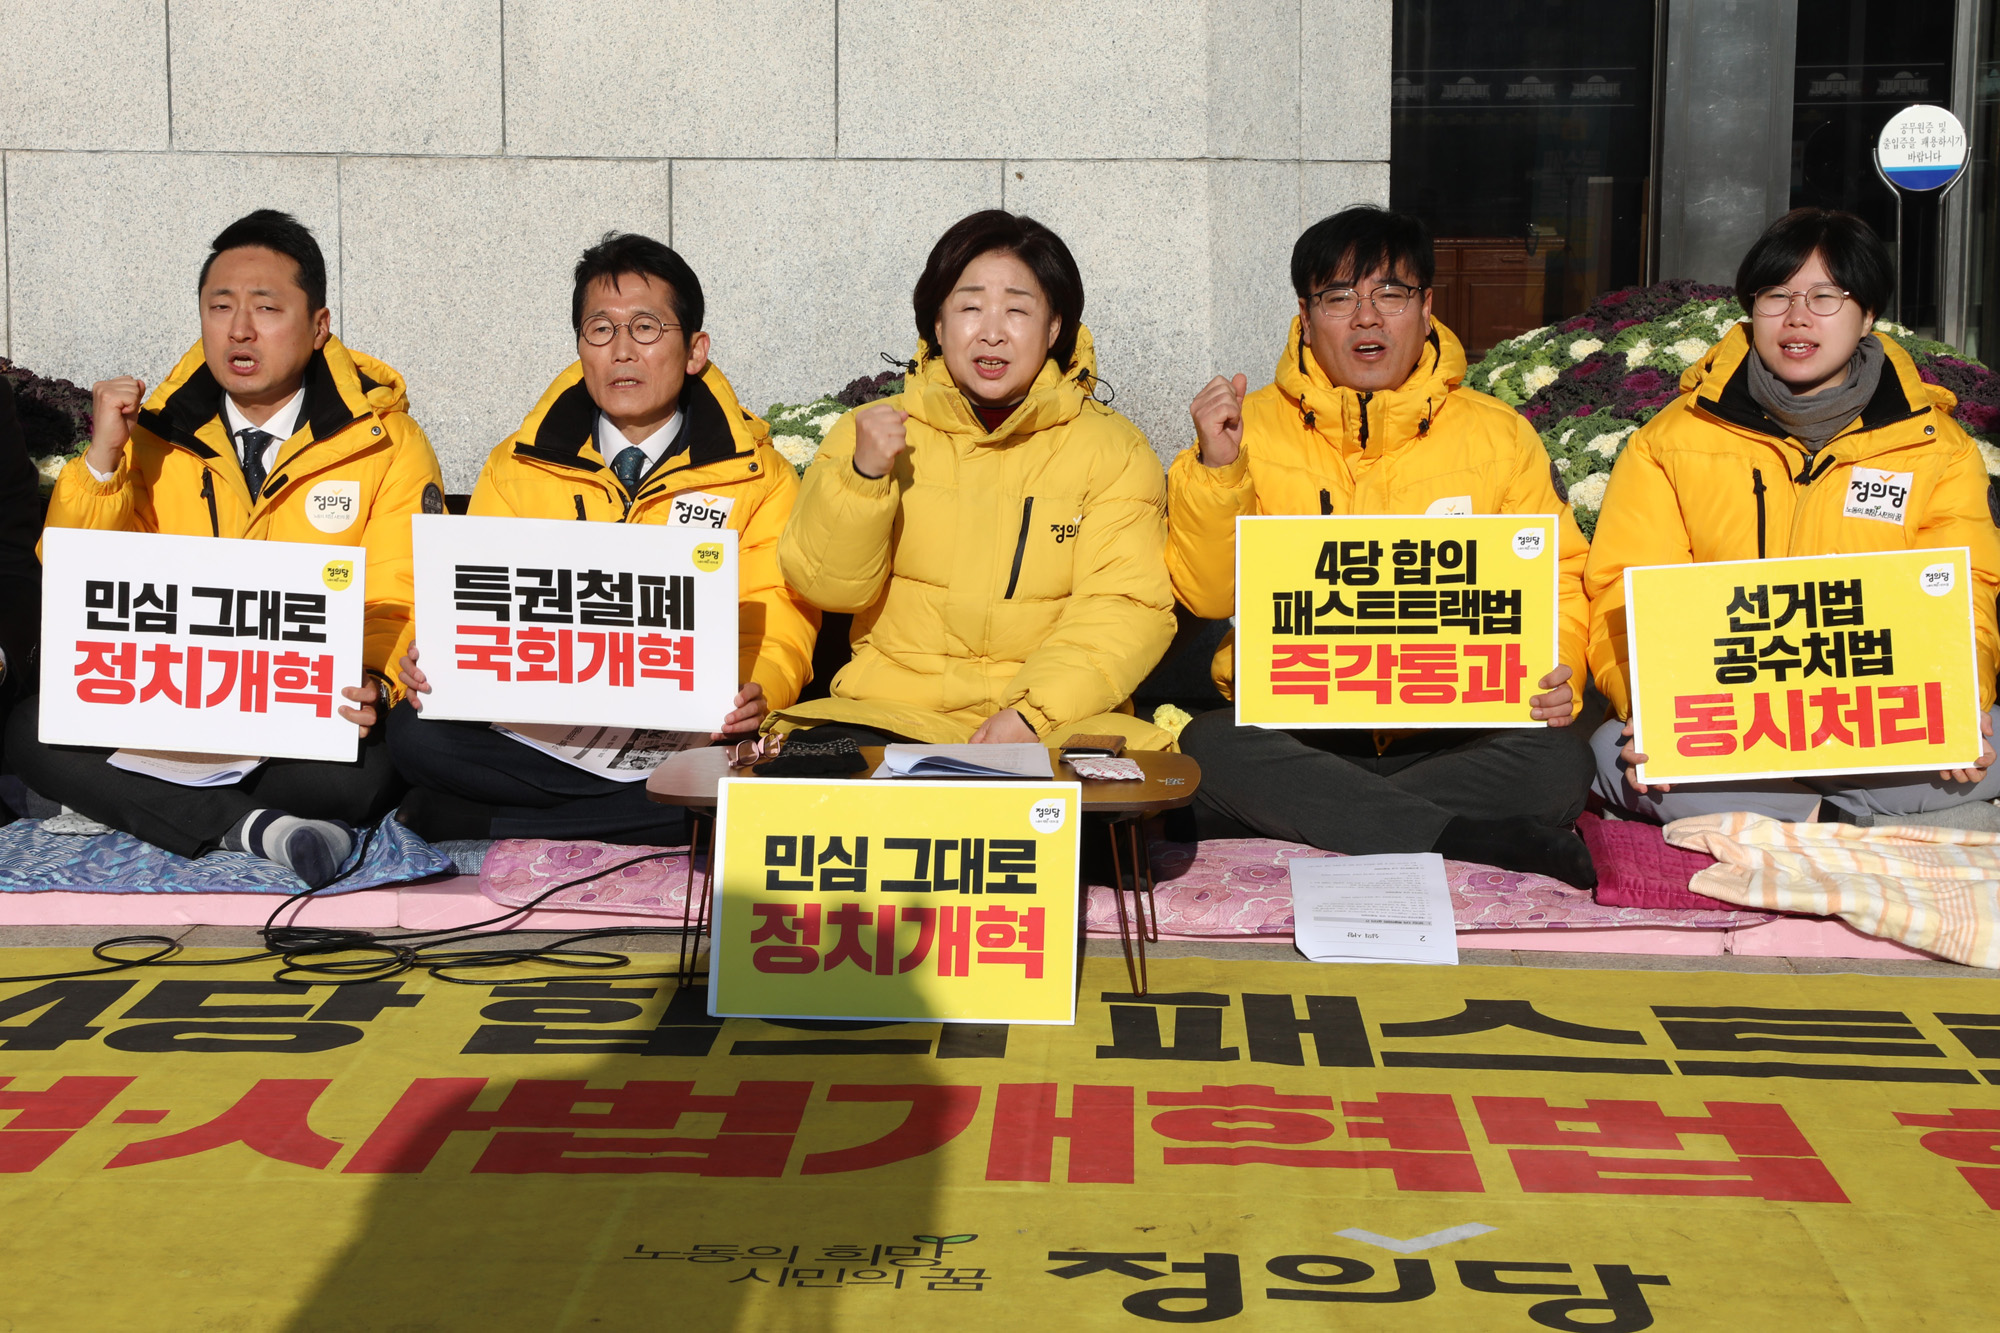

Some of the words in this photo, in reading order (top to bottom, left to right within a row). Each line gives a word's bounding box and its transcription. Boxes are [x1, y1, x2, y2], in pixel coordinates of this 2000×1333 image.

[1882, 136, 1917, 149] 출입증을
[1921, 135, 1963, 147] 패용하시기
[1900, 121, 1934, 134] 공무원증
[1938, 121, 1947, 133] 및
[1907, 150, 1942, 162] 바랍니다
[313, 495, 352, 511] 정의당
[1851, 480, 1907, 508] 정의당
[675, 500, 727, 529] 정의당
[1050, 524, 1080, 544] 정의
[1517, 536, 1541, 546] 정의당
[327, 567, 349, 578] 정의당
[697, 549, 720, 560] 정의당
[1314, 540, 1383, 586] 4당
[1391, 539, 1477, 586] 합의
[1925, 572, 1950, 583] 정의당
[85, 580, 178, 635] 민심
[189, 586, 327, 643] 그대로
[453, 564, 695, 631] 특권철폐
[1272, 589, 1522, 636] 패스트트랙법
[1726, 579, 1864, 632] 선거법
[455, 625, 694, 692] 국회개혁
[1270, 643, 1528, 705] 즉각통과
[1713, 629, 1894, 684] 공수처법
[74, 640, 334, 718] 정치개혁
[1673, 682, 1945, 757] 동시처리
[1035, 807, 1060, 818] 정의당
[764, 835, 868, 893] 민심
[880, 837, 1037, 895] 그대로
[750, 903, 1046, 979] 정치개혁
[0, 979, 425, 1054] 4당
[1096, 992, 2000, 1086] 패스트
[623, 1243, 799, 1264] 노동의
[814, 1239, 954, 1267] 희망
[728, 1266, 904, 1290] 시민의
[919, 1267, 992, 1292] 꿈
[1045, 1251, 1672, 1333] 정의당
